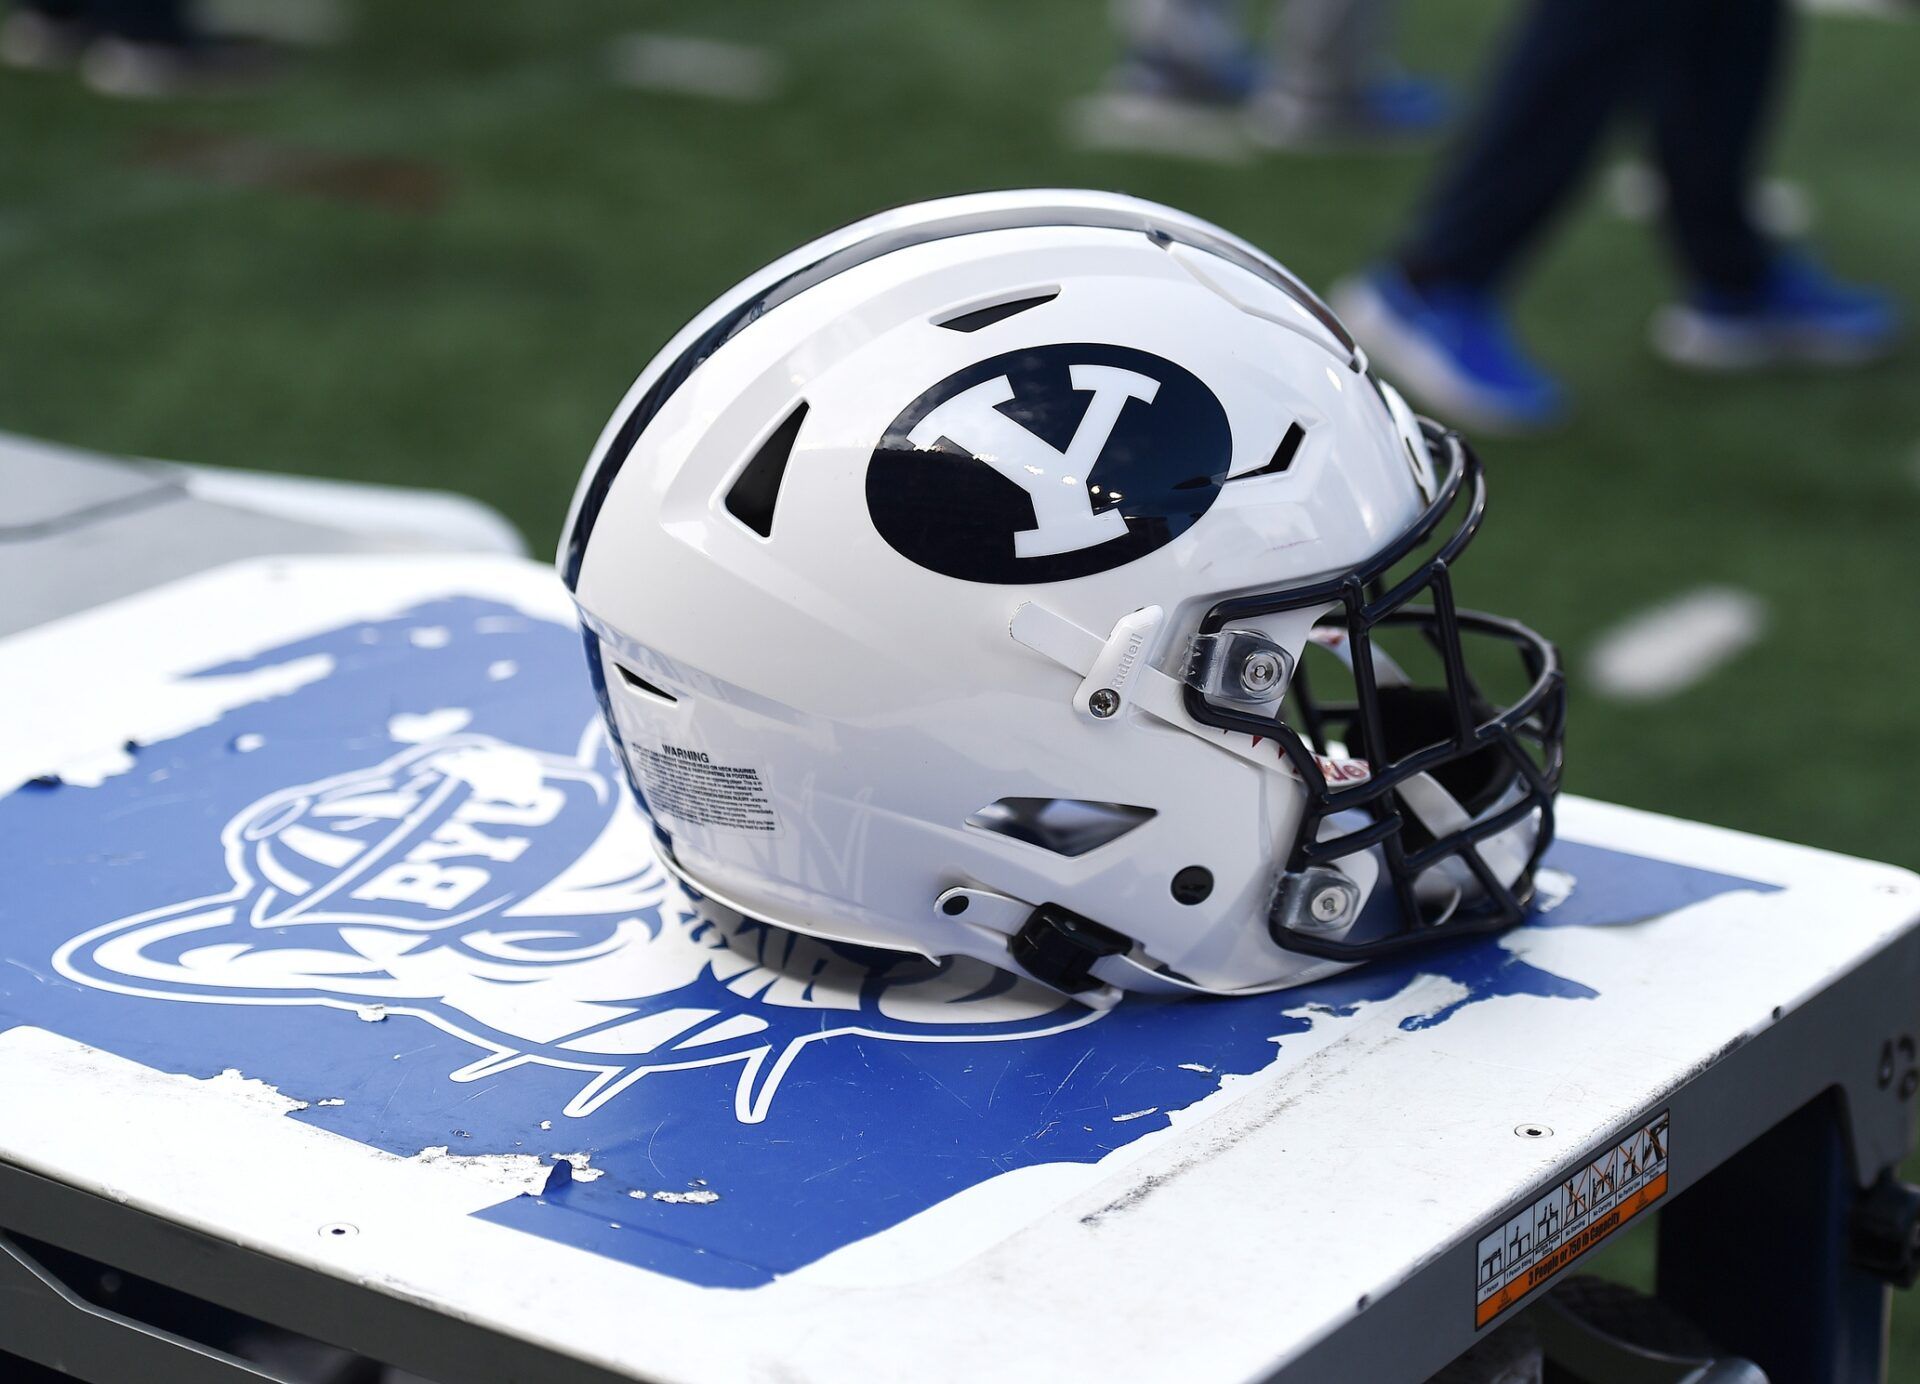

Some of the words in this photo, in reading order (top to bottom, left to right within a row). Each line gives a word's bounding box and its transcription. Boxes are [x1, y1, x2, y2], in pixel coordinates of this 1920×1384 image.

[906, 364, 1161, 558] Y
[662, 744, 710, 763] WARNING
[1535, 1255, 1559, 1281] People
[1590, 1210, 1620, 1241] Capacity
